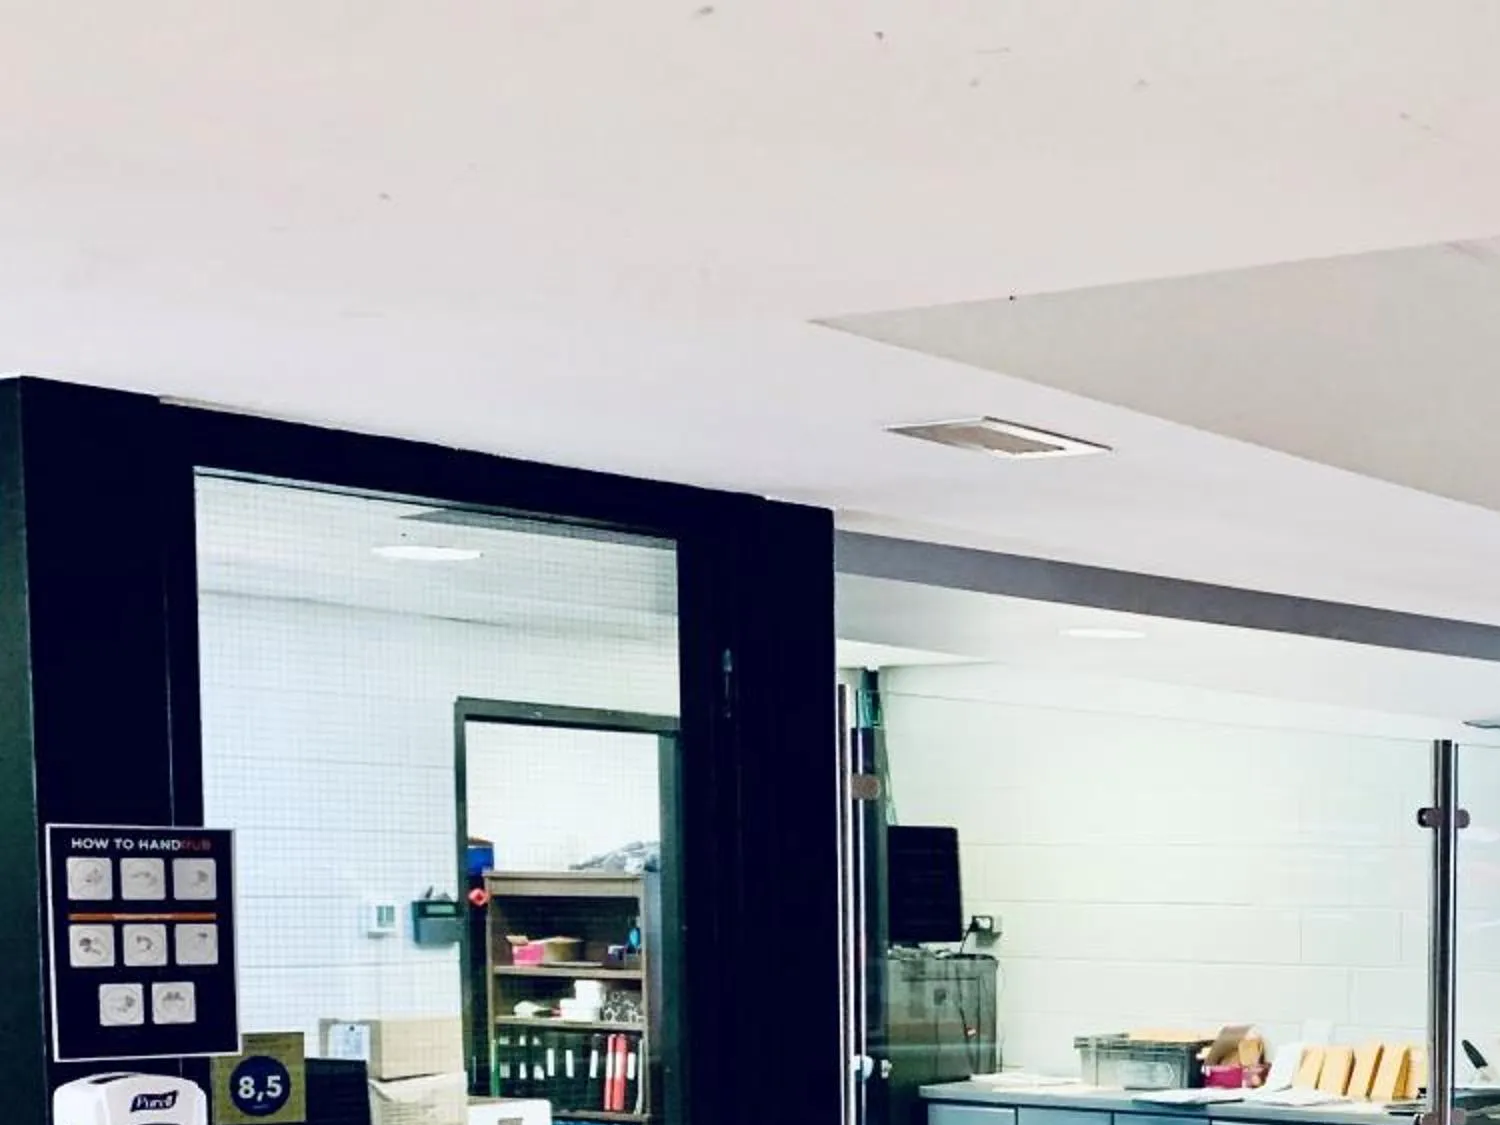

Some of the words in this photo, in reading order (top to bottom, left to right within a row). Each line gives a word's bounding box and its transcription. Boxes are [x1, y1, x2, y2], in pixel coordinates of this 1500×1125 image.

[71, 838, 109, 849] HOW
[113, 838, 134, 850] TO
[238, 1075, 282, 1102] 8,5
